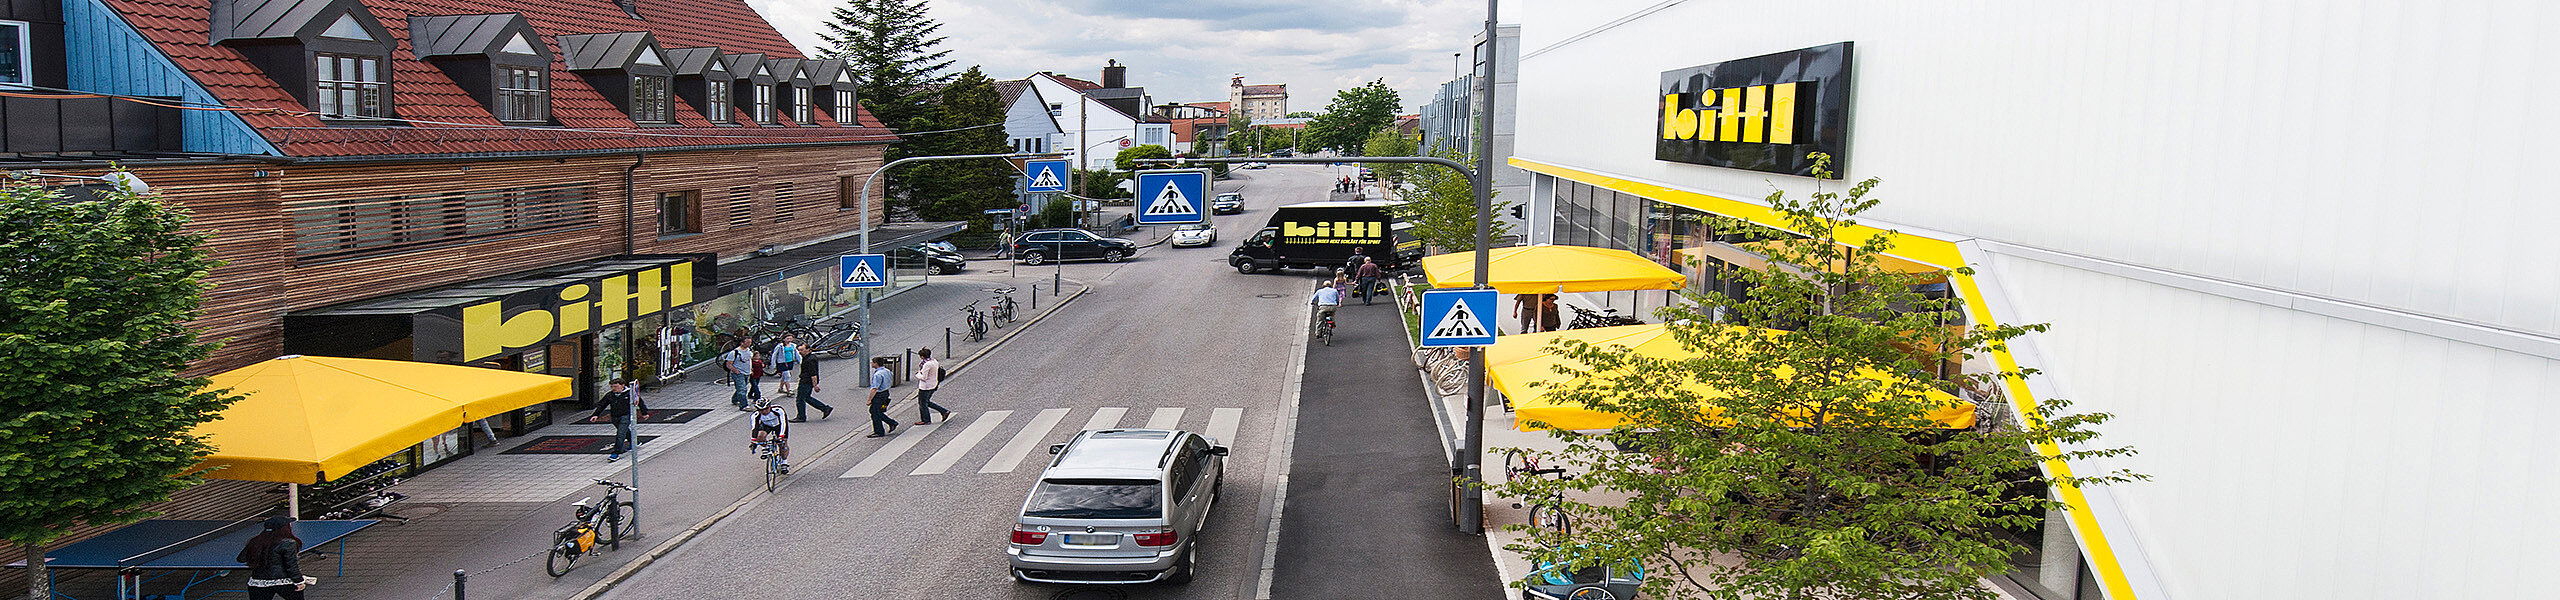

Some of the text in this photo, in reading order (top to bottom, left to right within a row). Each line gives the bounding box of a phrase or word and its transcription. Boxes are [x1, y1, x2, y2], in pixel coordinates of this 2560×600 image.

[1663, 82, 1796, 144] bittl
[1284, 221, 1381, 237] bittl
[463, 261, 692, 362] bittl
